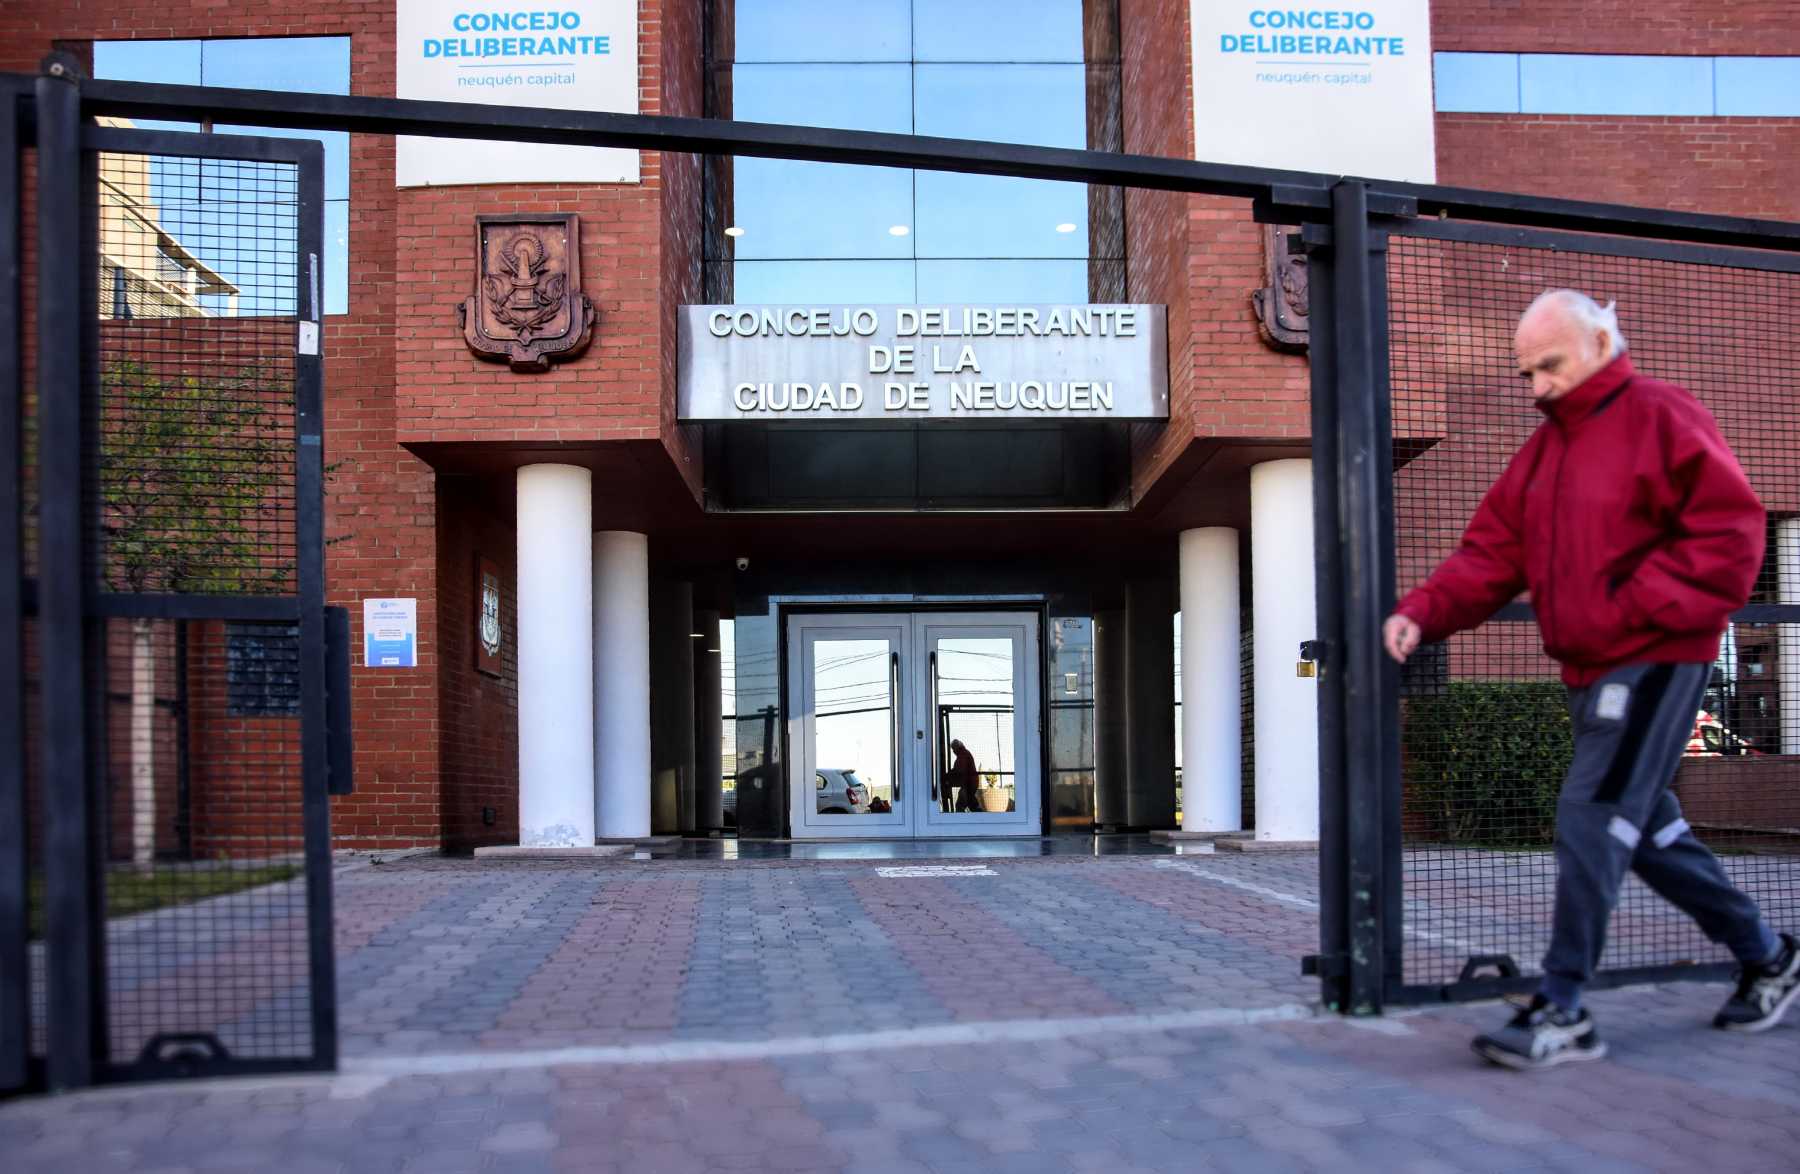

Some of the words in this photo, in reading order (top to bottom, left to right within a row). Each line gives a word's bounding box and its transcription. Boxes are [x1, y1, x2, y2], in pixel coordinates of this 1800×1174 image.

[453, 11, 581, 32] CONCEJO
[1249, 10, 1375, 30] CONCEJO
[423, 36, 610, 58] DELIBERANTE
[1220, 34, 1404, 56] DELIBERANTE
[457, 73, 523, 88] neuquén
[527, 72, 575, 86] capital
[1255, 71, 1320, 85] neuquén
[1324, 72, 1372, 86] capital
[708, 308, 879, 338] CONCEJO
[896, 308, 1137, 338] DELIBERANTE
[868, 345, 914, 374] DE
[932, 345, 982, 374] LA
[733, 383, 864, 412] CIUDAD
[884, 382, 930, 411] DE
[950, 381, 1114, 411] NEUQUEN
